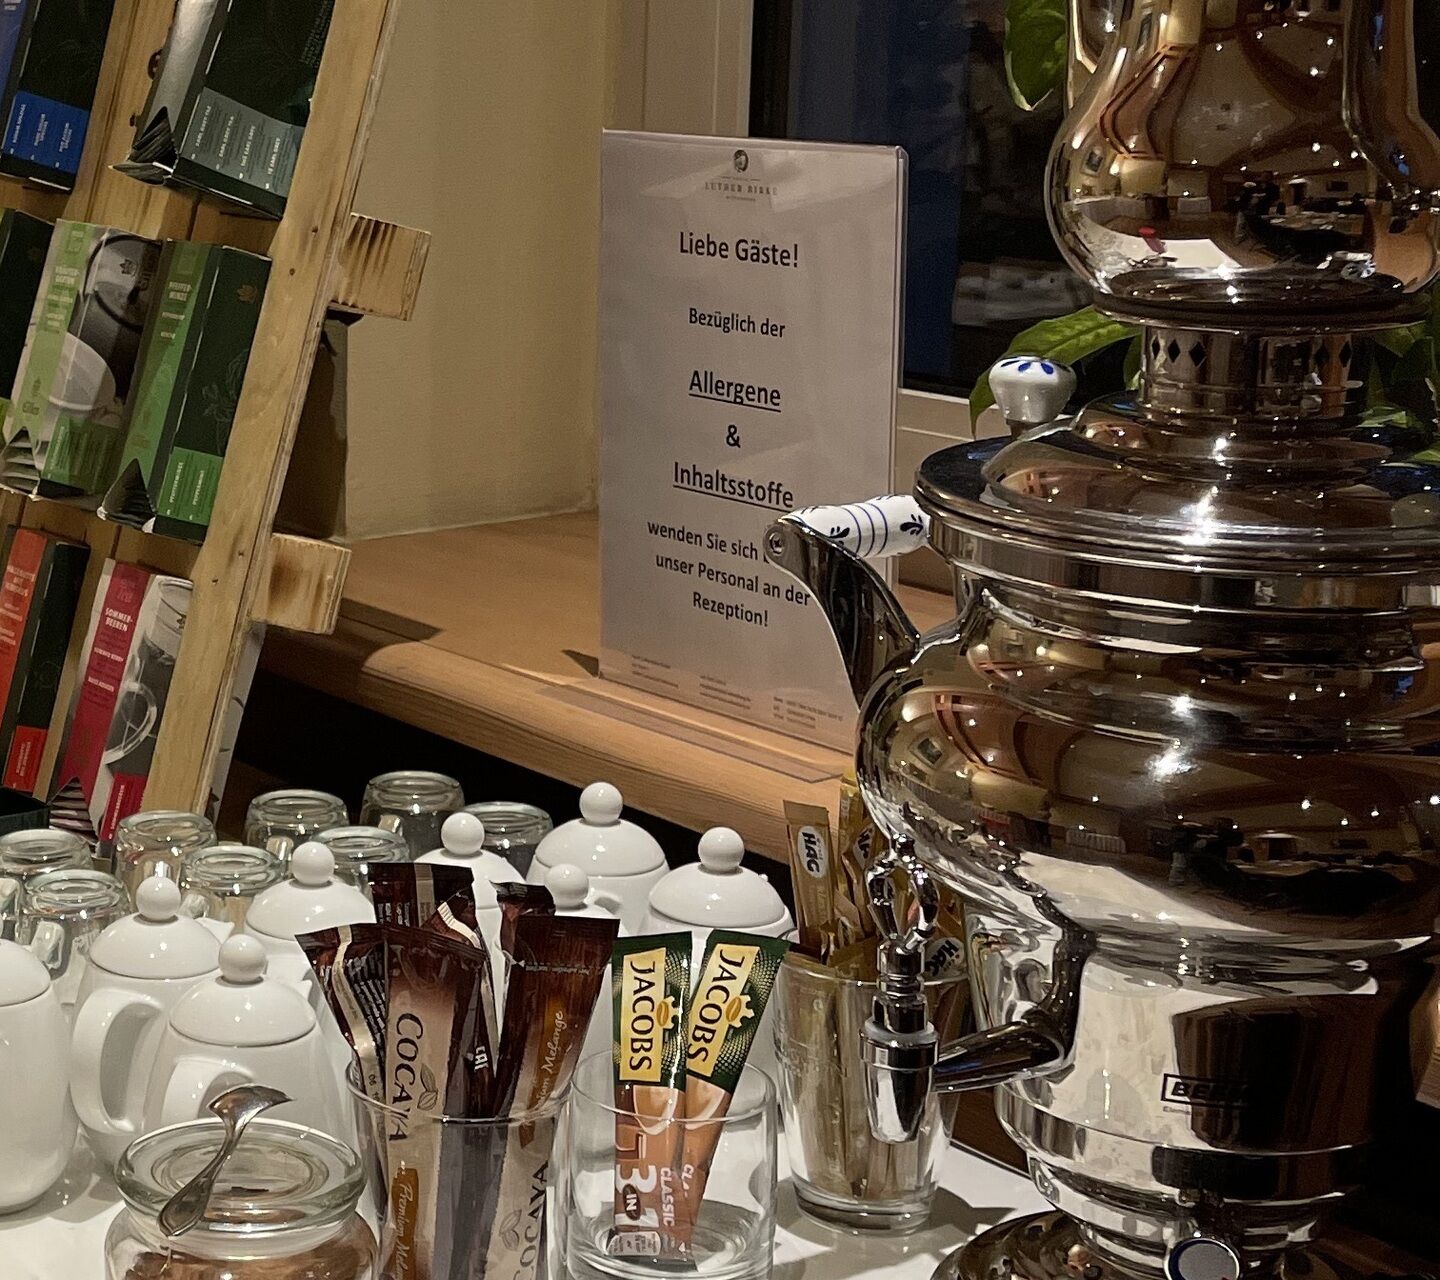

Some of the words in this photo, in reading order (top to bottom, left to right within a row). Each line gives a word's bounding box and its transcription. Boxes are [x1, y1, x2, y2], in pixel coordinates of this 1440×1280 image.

[679, 231, 729, 259] Liebe
[735, 238, 799, 268] Gäste!
[688, 307, 756, 334] Bezüglich
[760, 318, 786, 338] der
[688, 370, 781, 408] Allergene
[726, 424, 741, 448] &
[674, 461, 794, 508] Inhaltsstoffe
[647, 521, 702, 547] wenden
[706, 533, 727, 553] Sie
[731, 540, 758, 561] sich
[656, 554, 694, 576] unser
[698, 562, 759, 593] Personal
[763, 582, 781, 599] an
[785, 585, 811, 607] der
[692, 591, 769, 627] Rezeption!
[802, 831, 820, 874] HAG
[629, 961, 656, 1071] JACOBS
[687, 949, 746, 1063] JACOBS
[388, 1012, 424, 1142] COCAYA
[615, 1164, 658, 1194] 3
[660, 1167, 676, 1227] CLASSIC
[626, 1193, 637, 1211] IN
